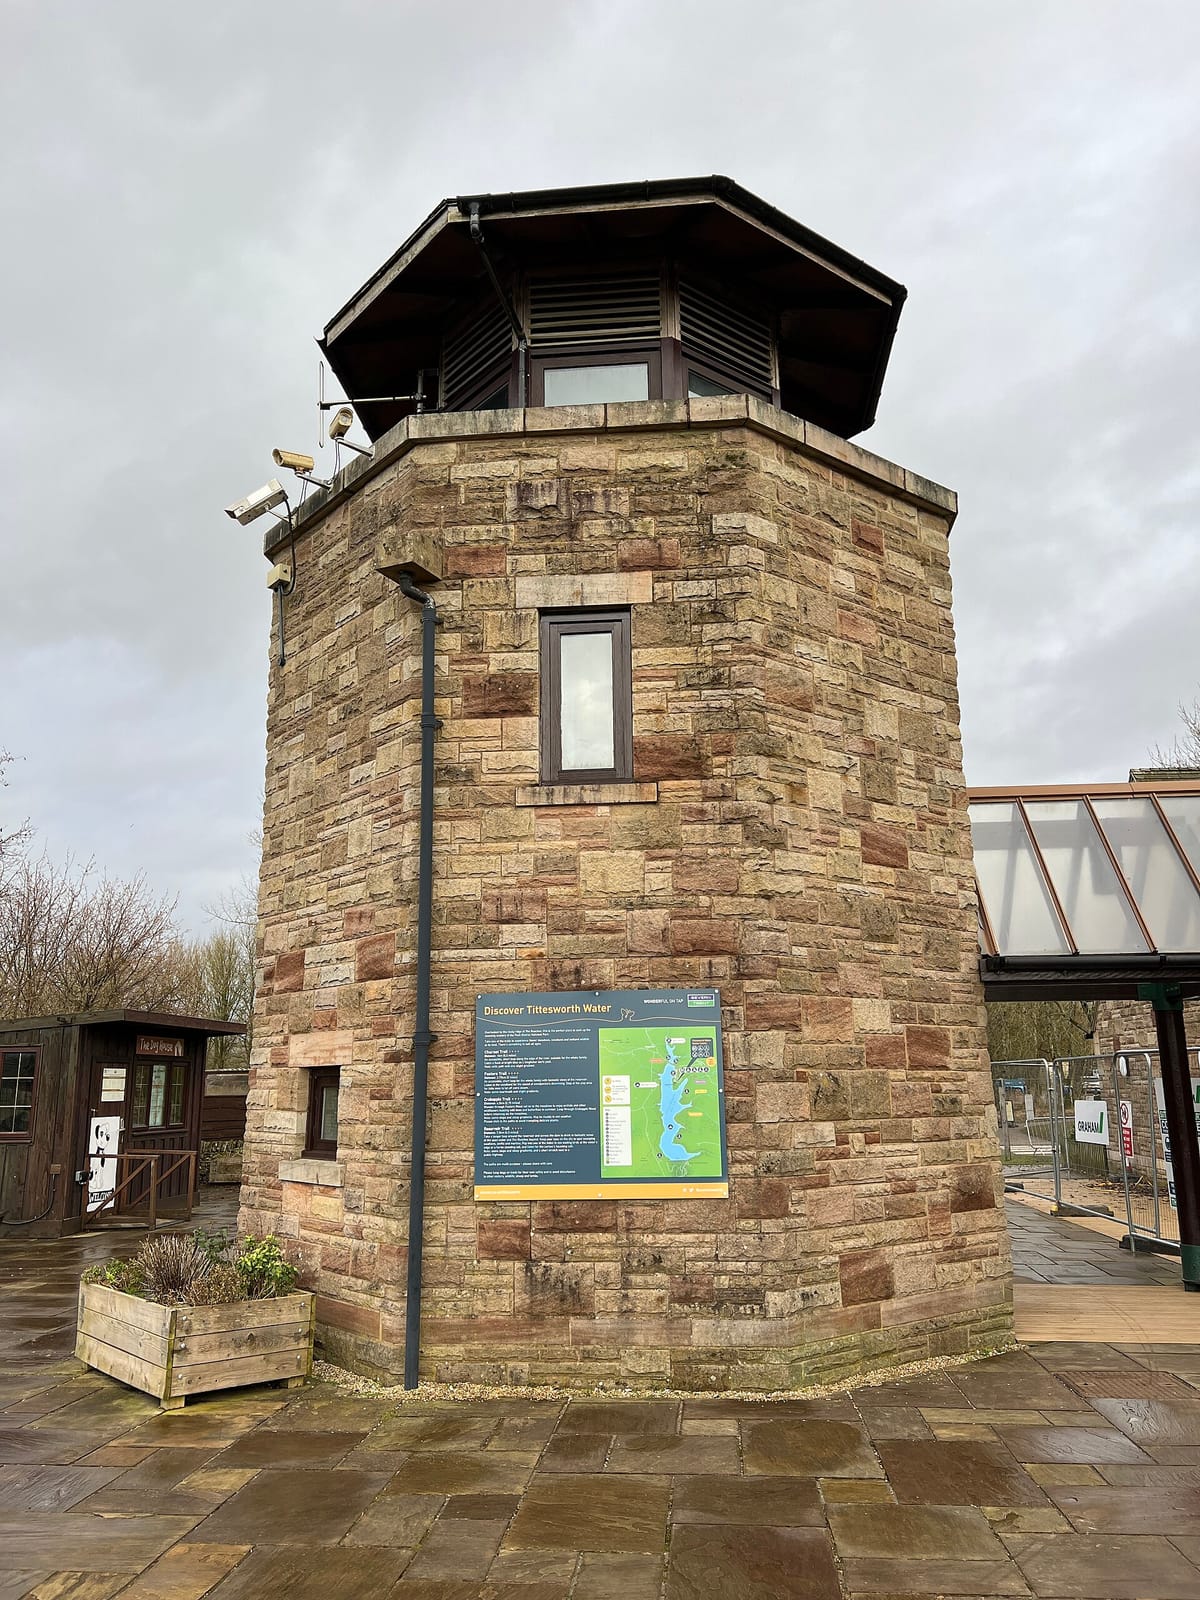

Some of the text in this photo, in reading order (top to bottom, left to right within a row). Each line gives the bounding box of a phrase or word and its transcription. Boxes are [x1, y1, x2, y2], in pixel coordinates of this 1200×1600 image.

[484, 1003, 612, 1015] Discover Tittesworth Water
[140, 1038, 150, 1050] The
[150, 1039, 159, 1054] Dog
[1077, 1120, 1099, 1134] GRAHAM
